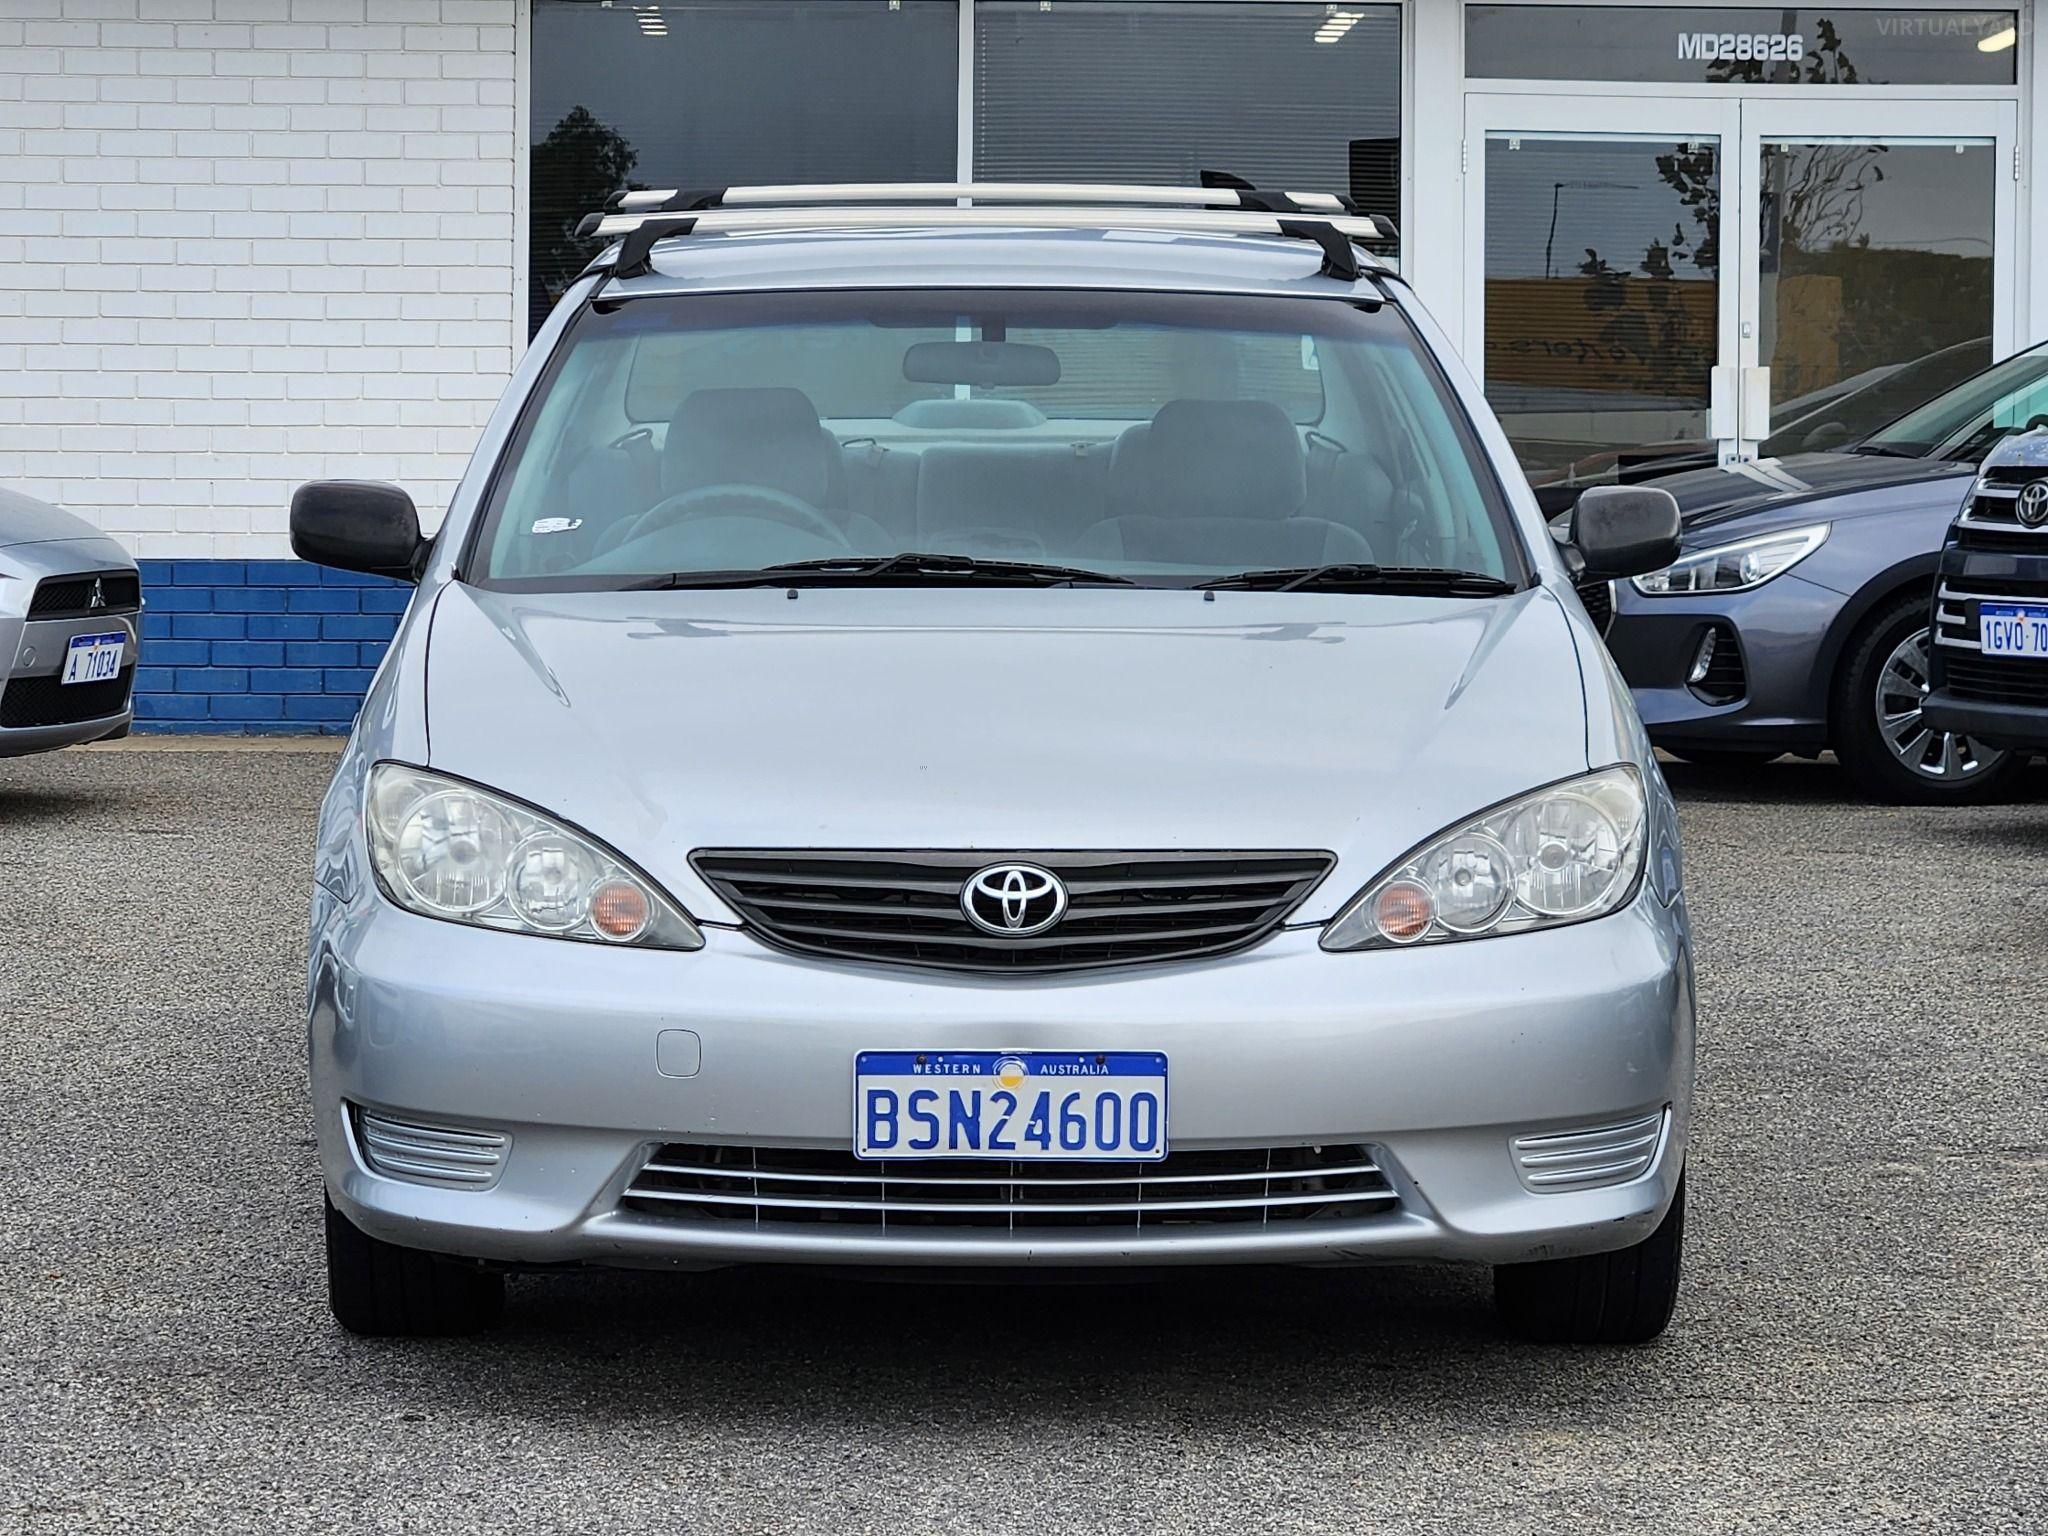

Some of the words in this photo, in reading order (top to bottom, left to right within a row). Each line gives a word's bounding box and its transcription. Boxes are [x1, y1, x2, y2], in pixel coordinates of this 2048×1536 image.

[1678, 33, 1803, 61] MD28626
[68, 653, 78, 681] A
[85, 650, 118, 680] 71034
[912, 1064, 981, 1075] WESTERN
[1040, 1064, 1110, 1076] AUSTRALIA
[866, 1089, 1158, 1151] BSN24600
